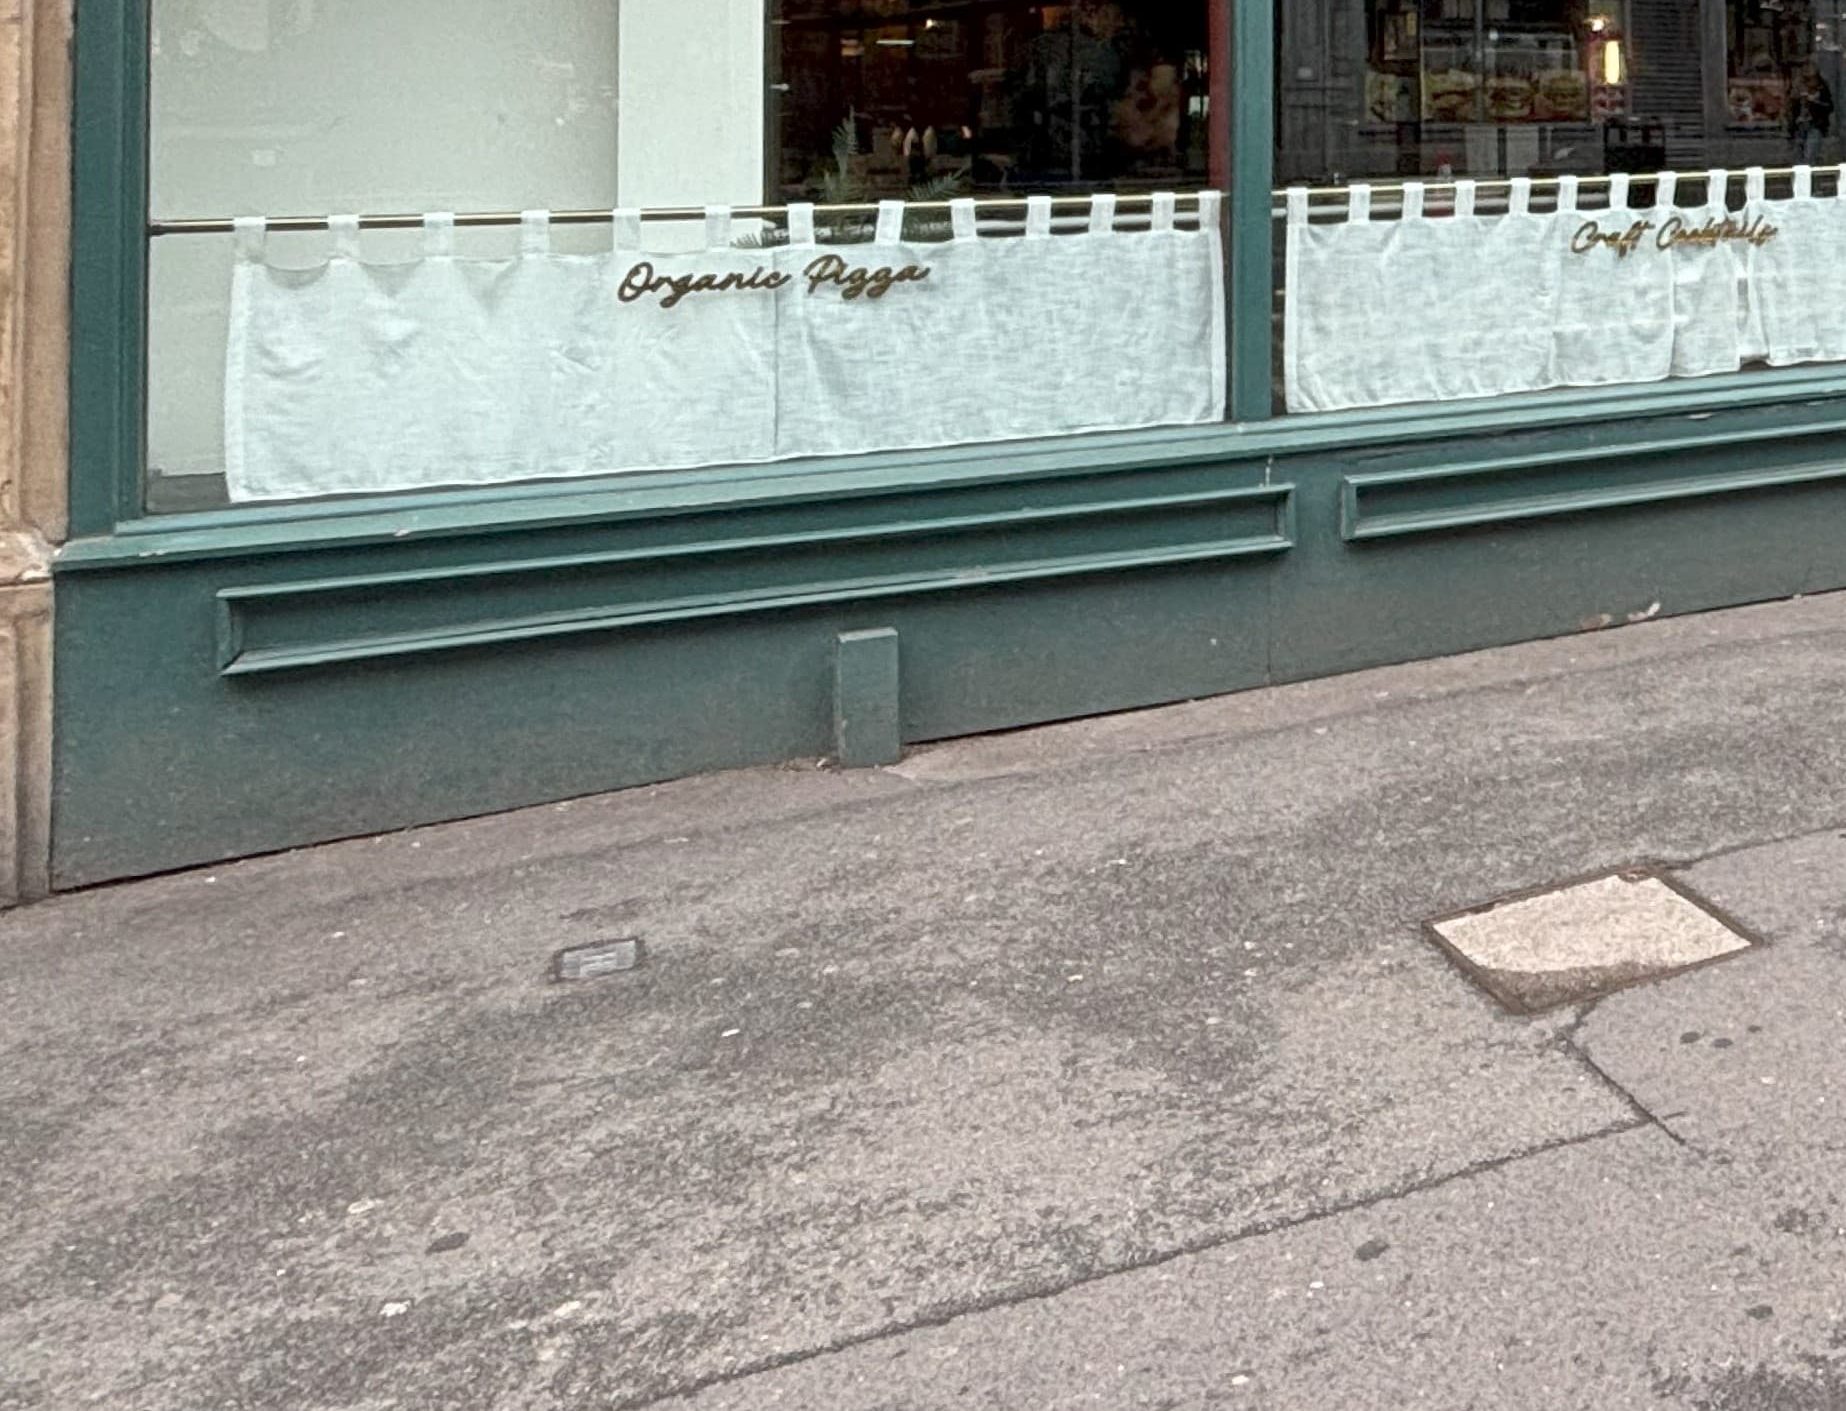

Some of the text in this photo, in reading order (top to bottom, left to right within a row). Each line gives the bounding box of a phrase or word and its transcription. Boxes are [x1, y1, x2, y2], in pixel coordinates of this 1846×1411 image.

[1571, 218, 1656, 258] Craft
[618, 254, 931, 309] Organic Pizza
